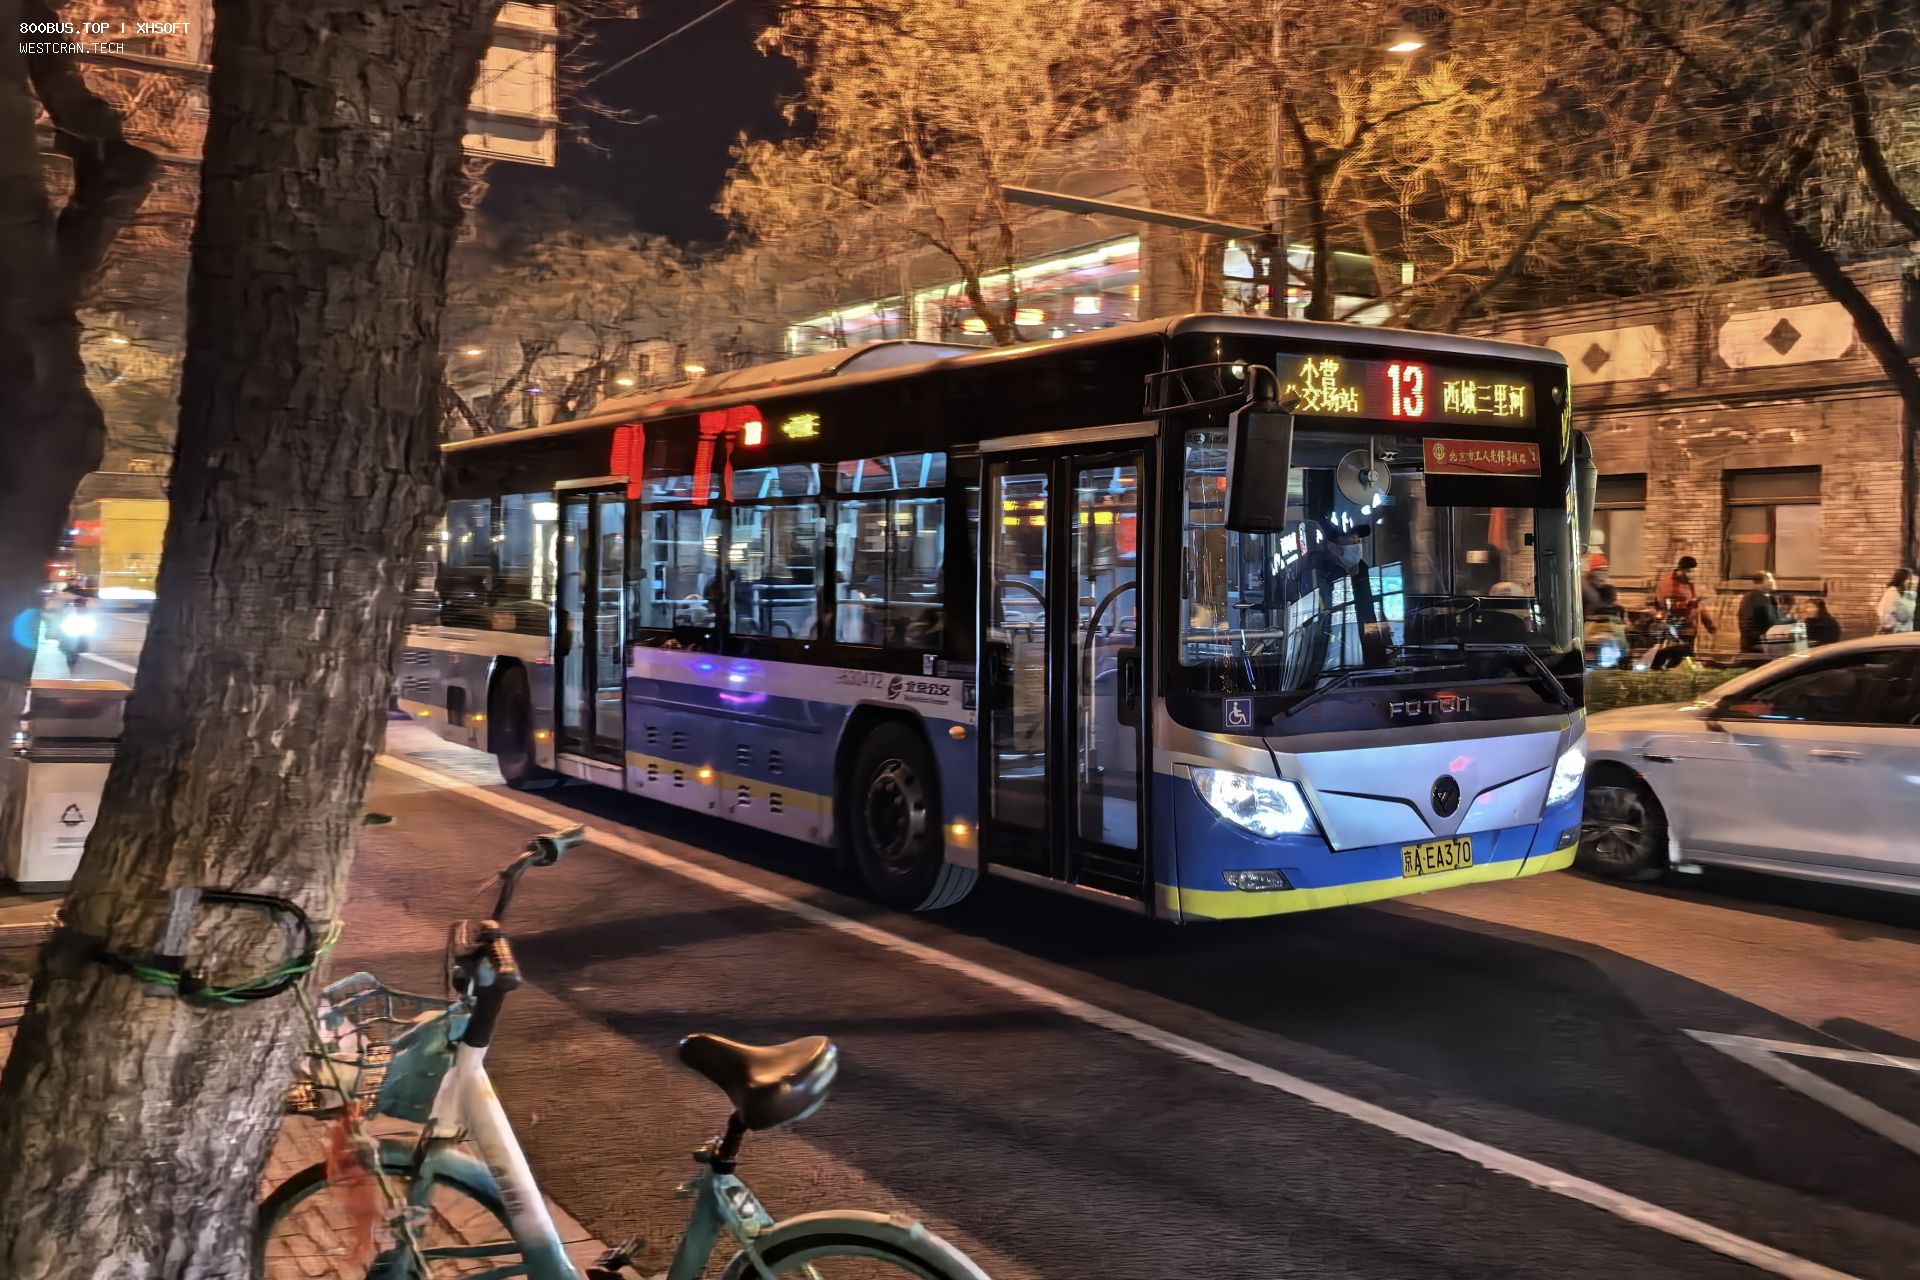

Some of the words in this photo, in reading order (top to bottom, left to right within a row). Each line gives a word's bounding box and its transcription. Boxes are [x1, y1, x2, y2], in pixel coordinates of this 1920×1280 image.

[1299, 357, 1339, 388] 小营
[1387, 364, 1425, 417] 13
[1442, 379, 1526, 418] 西城三里河
[1389, 696, 1471, 719] FOTON
